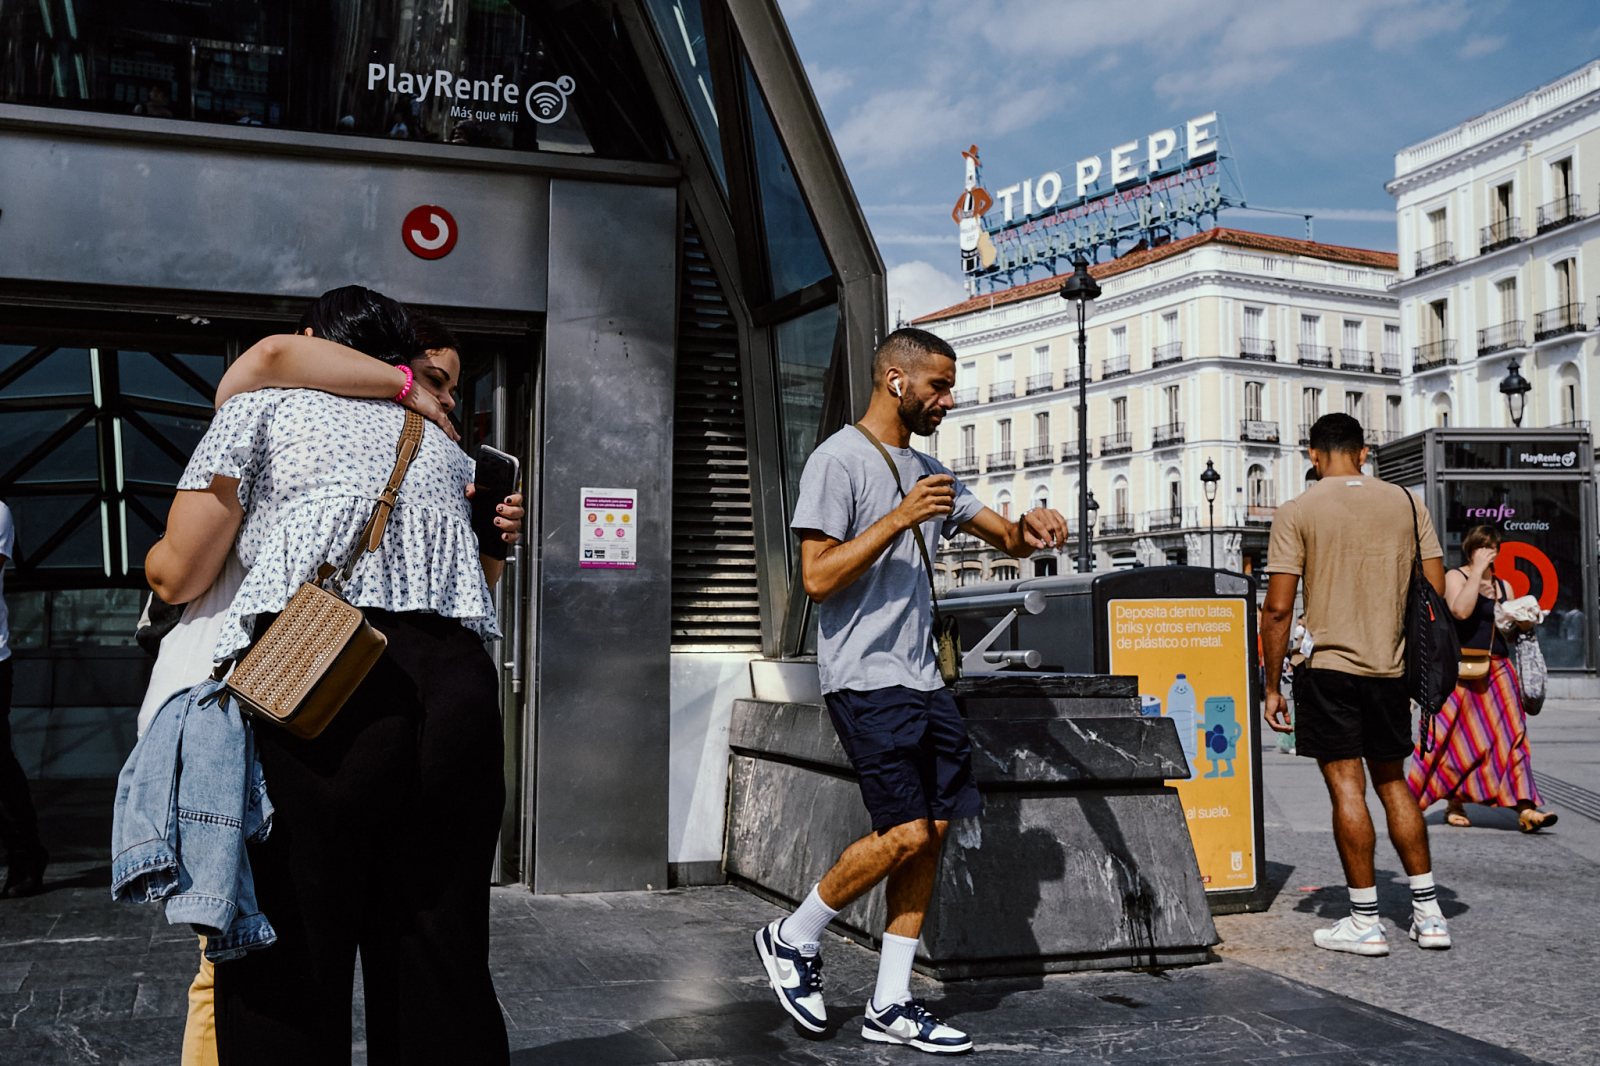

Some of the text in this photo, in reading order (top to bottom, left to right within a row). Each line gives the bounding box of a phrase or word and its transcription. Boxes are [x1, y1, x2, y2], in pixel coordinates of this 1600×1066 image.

[368, 63, 519, 104] PlayRenfe
[450, 105, 519, 122] Más que wifi
[997, 111, 1217, 222] TIO PEPE
[1520, 453, 1561, 464] PlayRenfe
[1466, 503, 1516, 522] renfe
[1504, 520, 1550, 530] Cercanías
[1116, 605, 1235, 620] Deposita dentro latas,
[1116, 621, 1231, 635] briks y otros envases
[1117, 633, 1223, 650] de plástico o metal.
[1187, 806, 1231, 819] al suelo.
